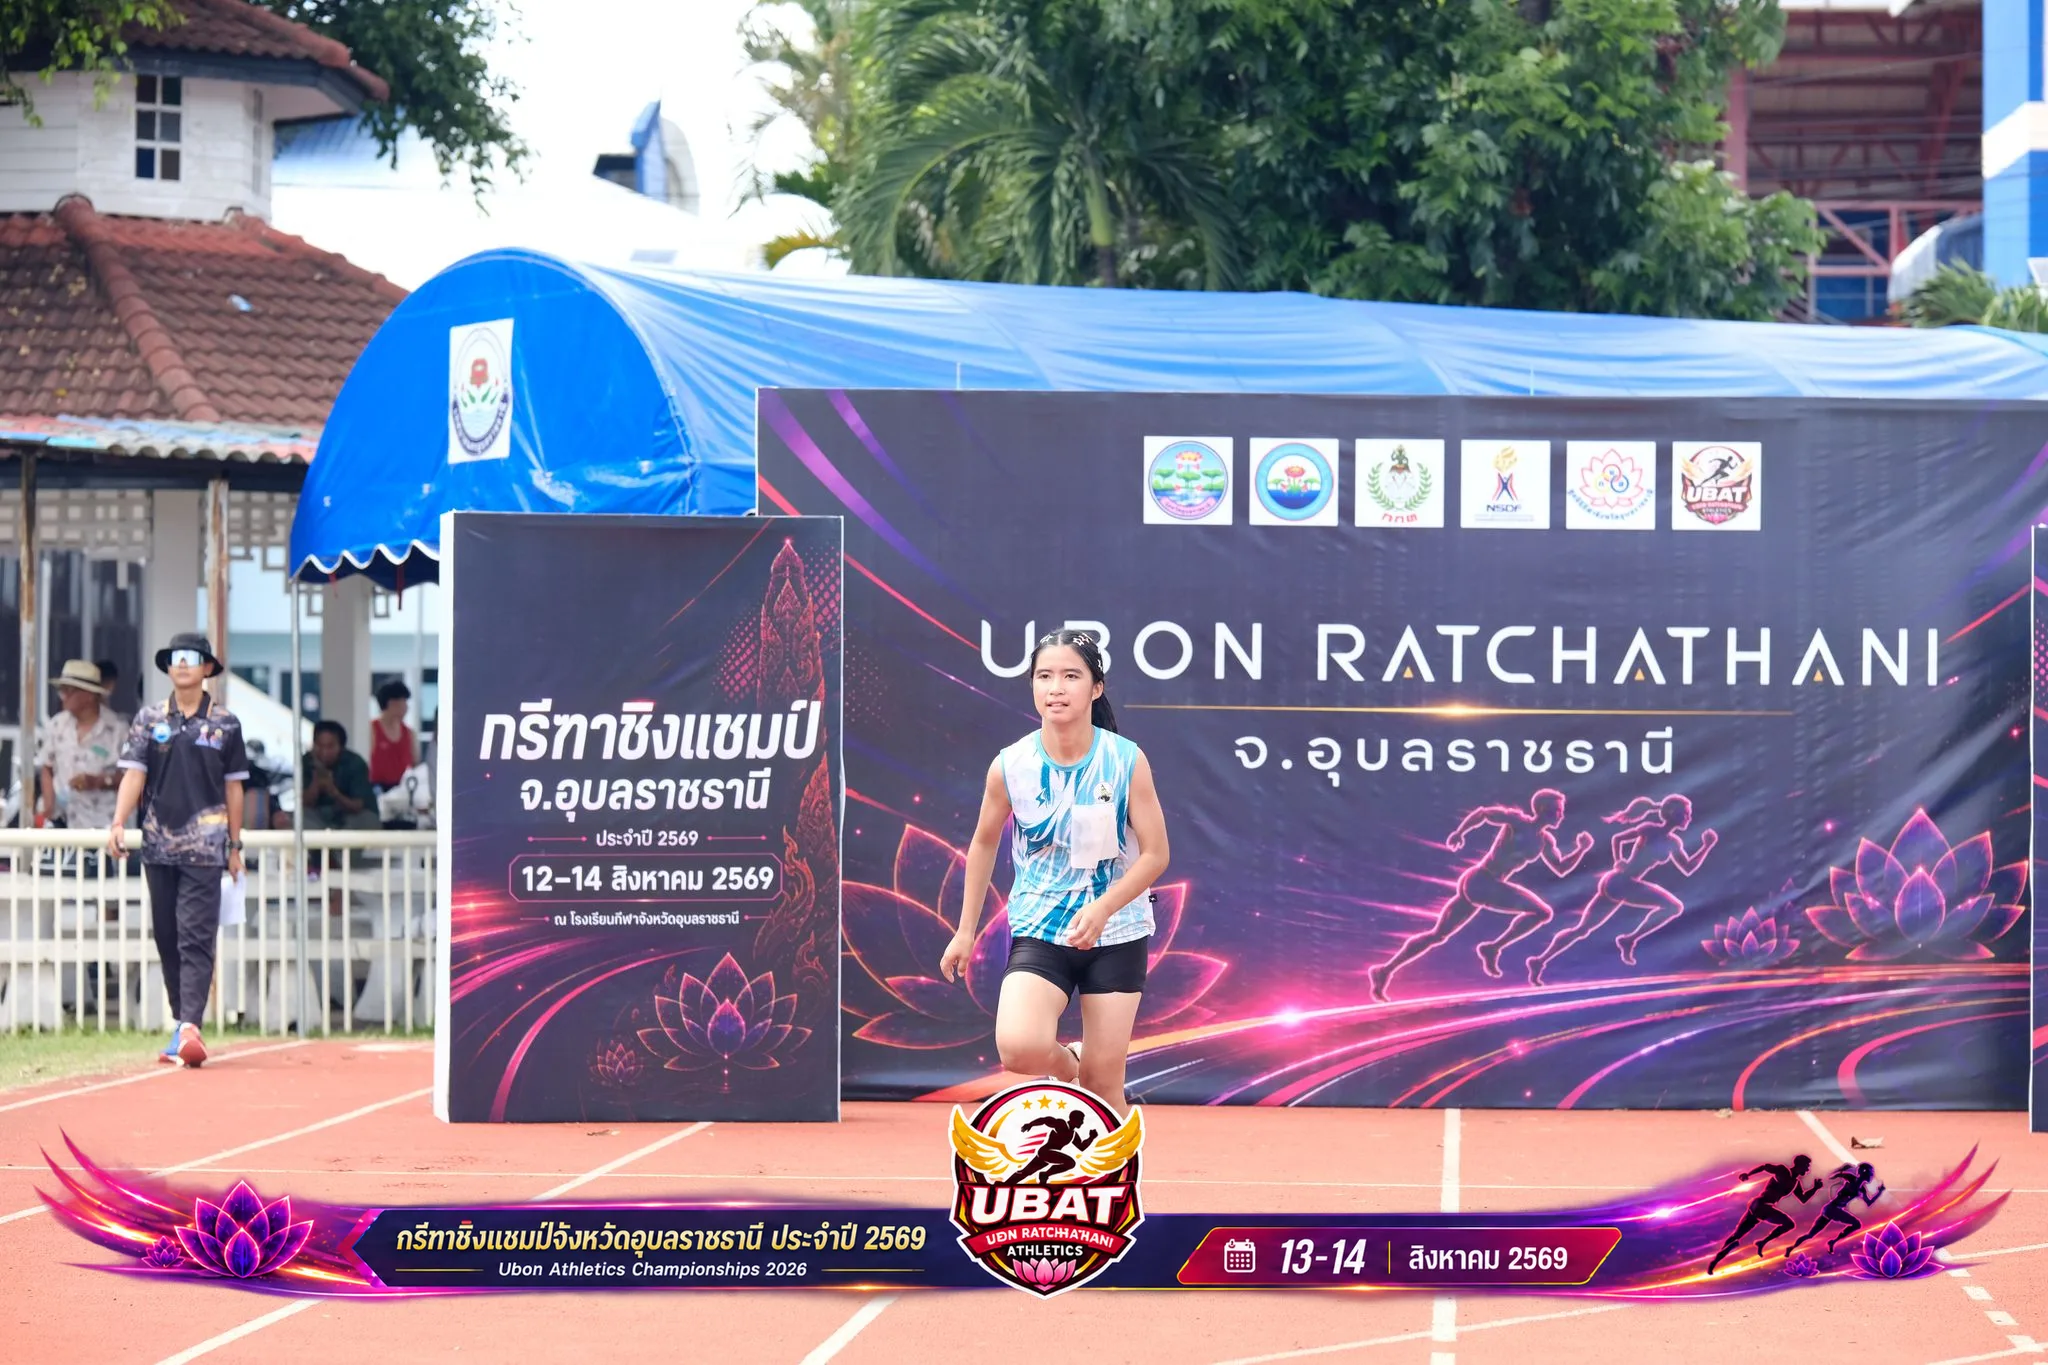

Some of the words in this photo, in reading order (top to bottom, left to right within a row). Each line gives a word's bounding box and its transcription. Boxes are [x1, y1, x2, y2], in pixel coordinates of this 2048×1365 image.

[1686, 486, 1748, 503] UBAT
[1317, 623, 1938, 687] RATCHATHANI
[479, 697, 822, 761] กรีฑาชิงแชมป์
[1234, 726, 1674, 788] จ.อุบลราชธานี
[520, 767, 772, 823] จ.อุบลราชธานี
[596, 828, 652, 847] ประจำปี
[657, 830, 699, 847] 2569
[611, 865, 703, 891] สิงหาคม
[711, 866, 774, 891] 2569
[554, 915, 567, 926] ณ
[570, 910, 740, 929] โรงเรียนกีฬาจังหวัดอุบลราชธานี
